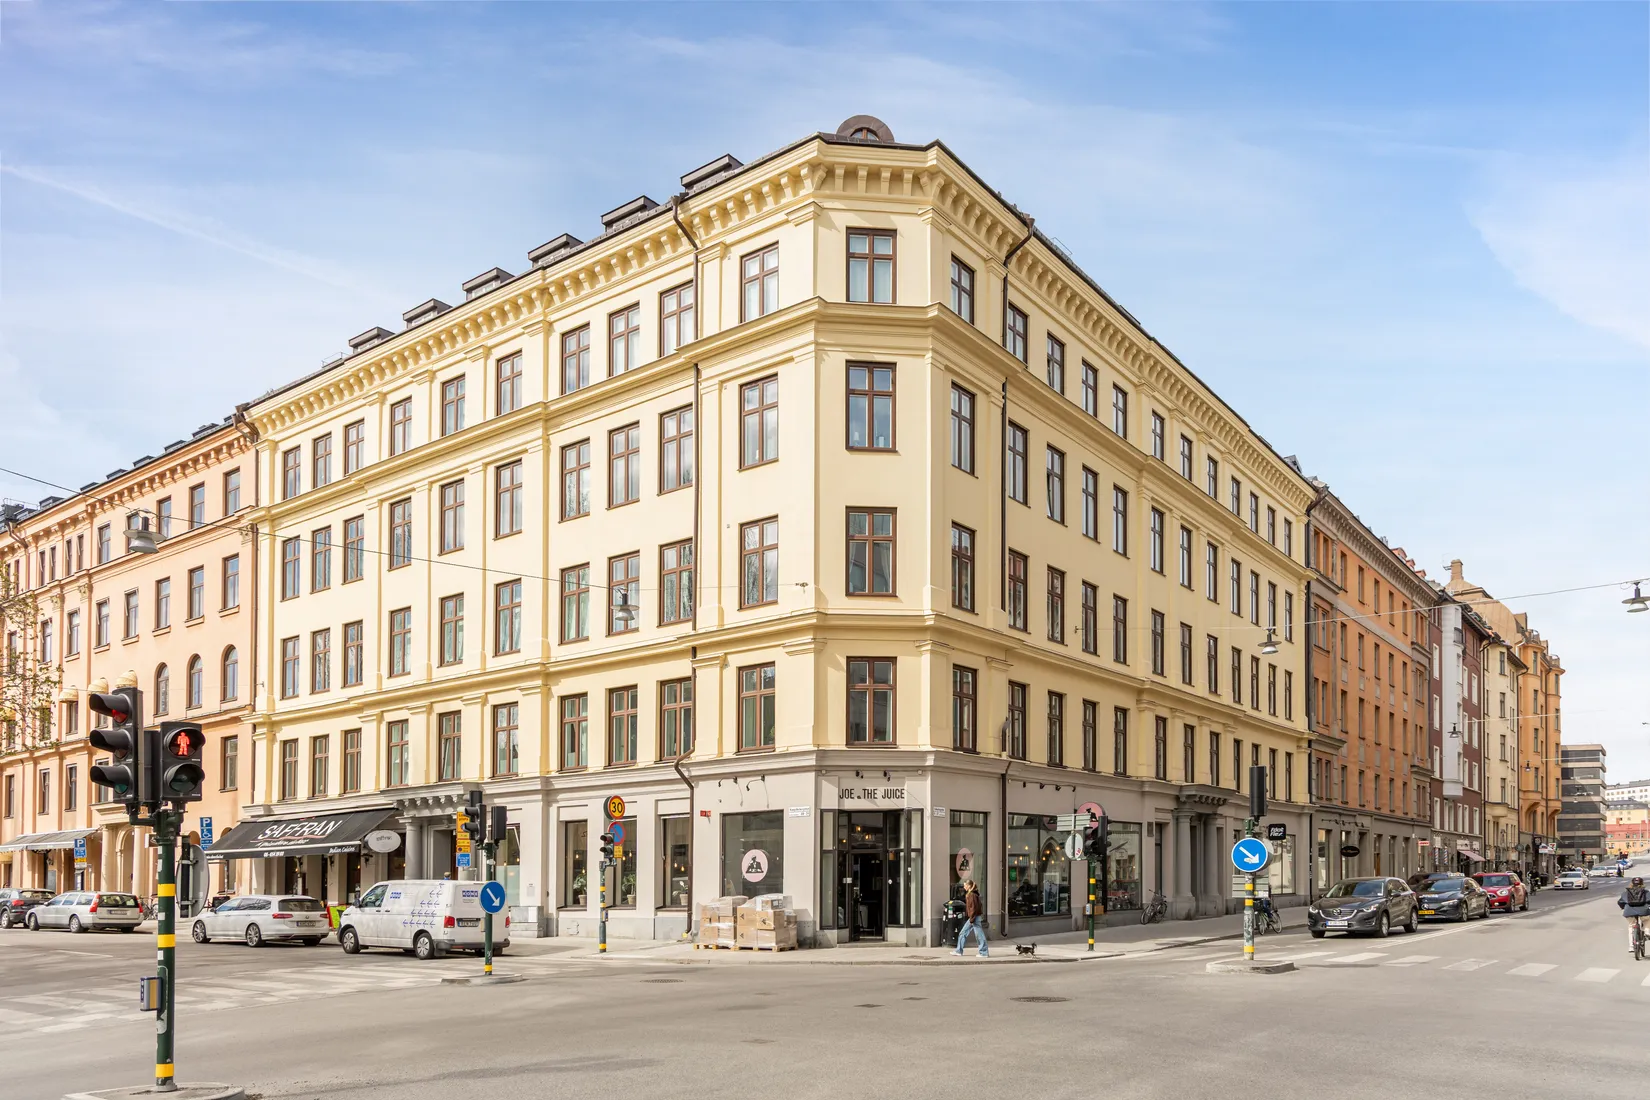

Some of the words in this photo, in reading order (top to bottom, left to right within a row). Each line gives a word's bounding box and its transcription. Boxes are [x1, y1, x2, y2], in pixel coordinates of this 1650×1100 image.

[839, 788, 854, 799] JOE
[862, 788, 878, 799] THE
[881, 788, 905, 799] JUICE
[611, 801, 623, 814] 30
[202, 817, 211, 827] P
[257, 820, 343, 839] SAFFRAN
[77, 839, 84, 848] P
